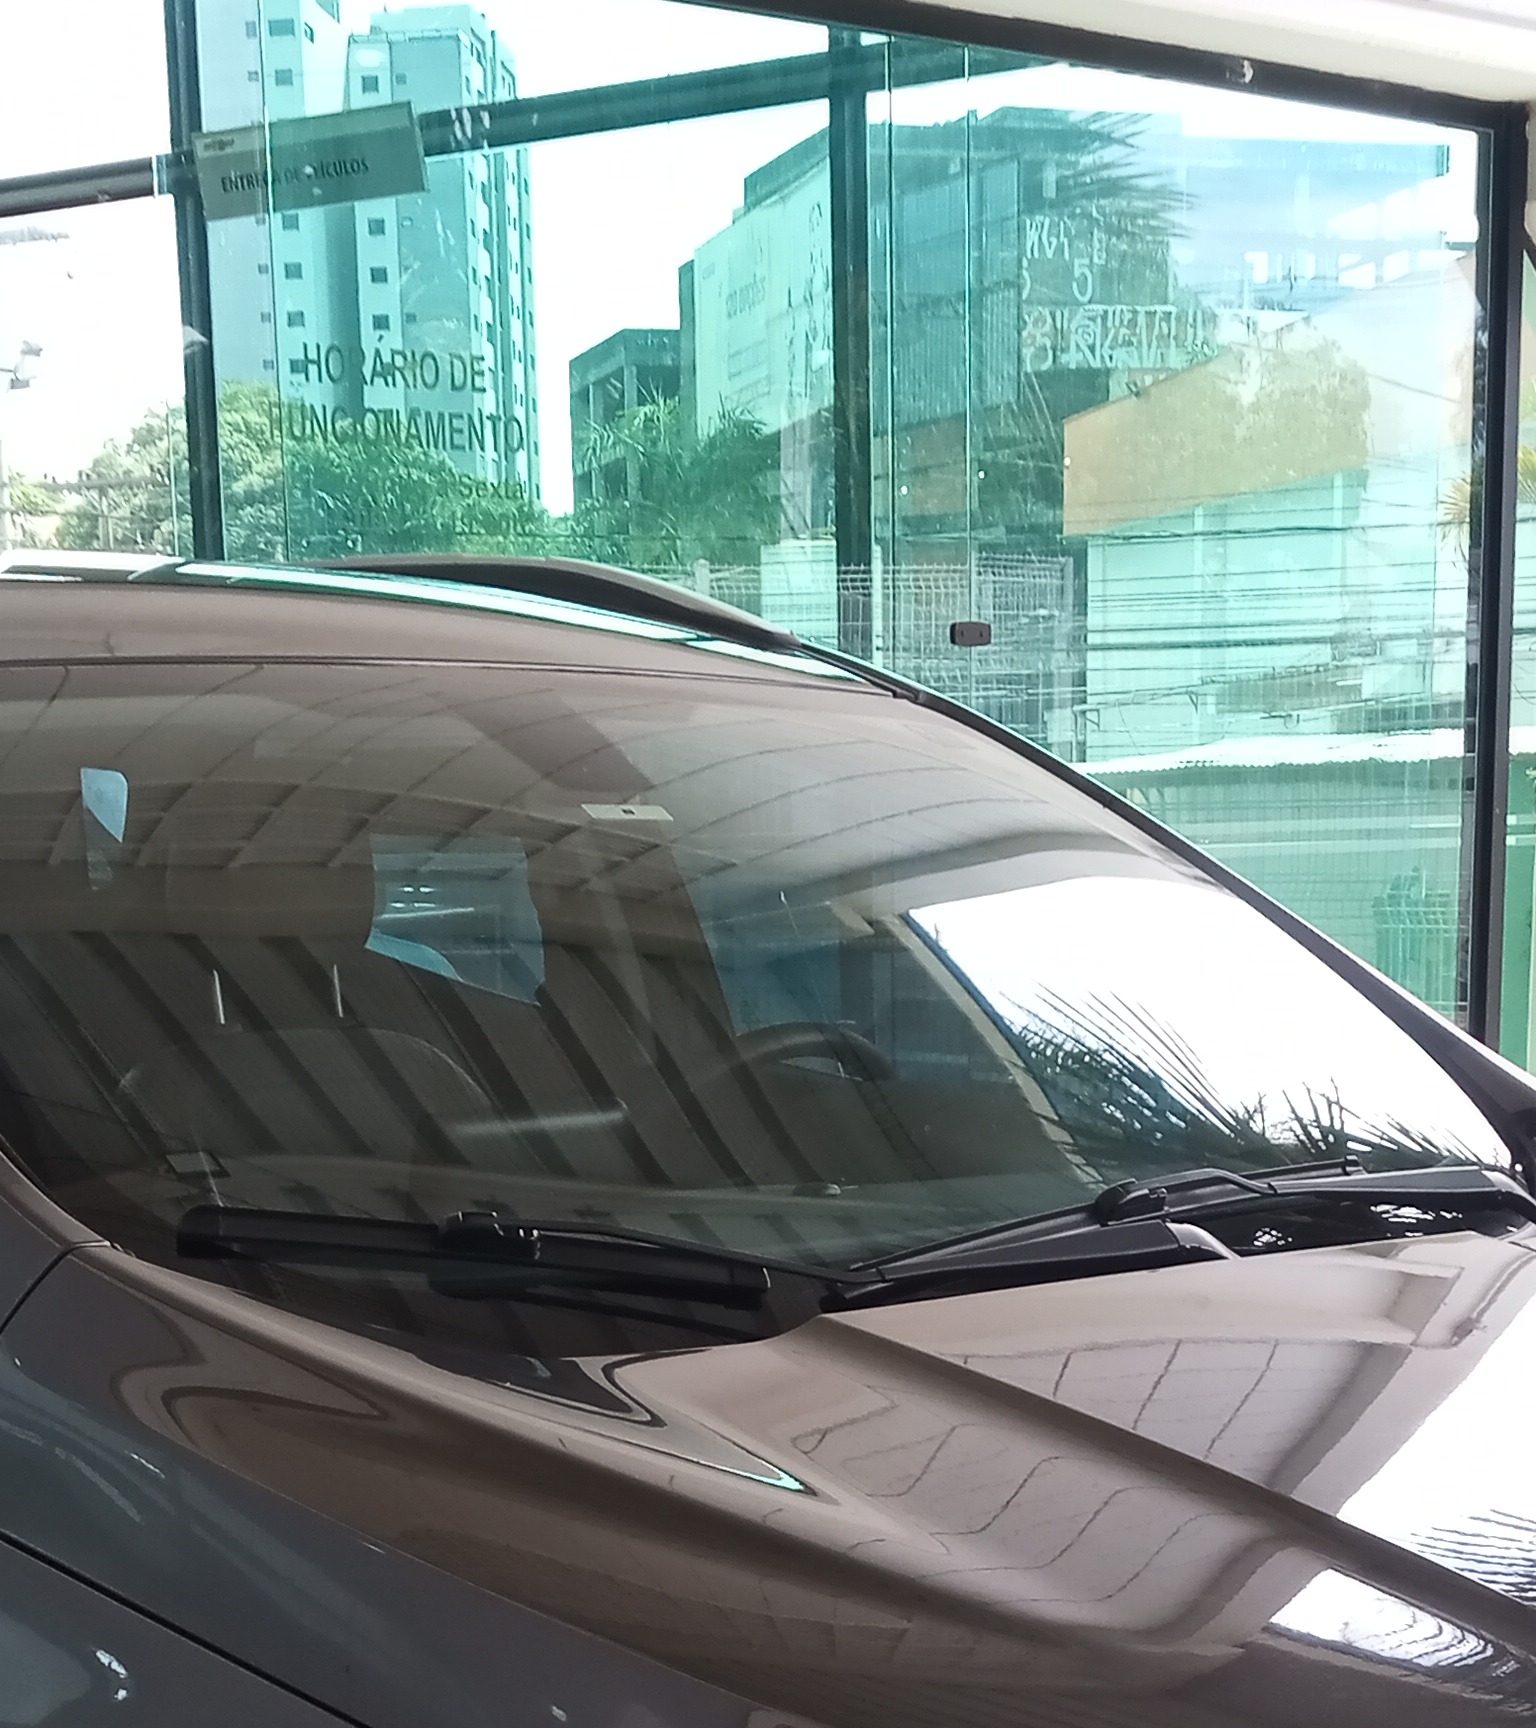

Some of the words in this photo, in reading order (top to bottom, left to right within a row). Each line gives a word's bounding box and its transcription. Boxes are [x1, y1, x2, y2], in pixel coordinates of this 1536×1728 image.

[221, 170, 282, 193] ENTREA
[303, 334, 440, 391] HOÁRIO
[449, 352, 487, 393] DE
